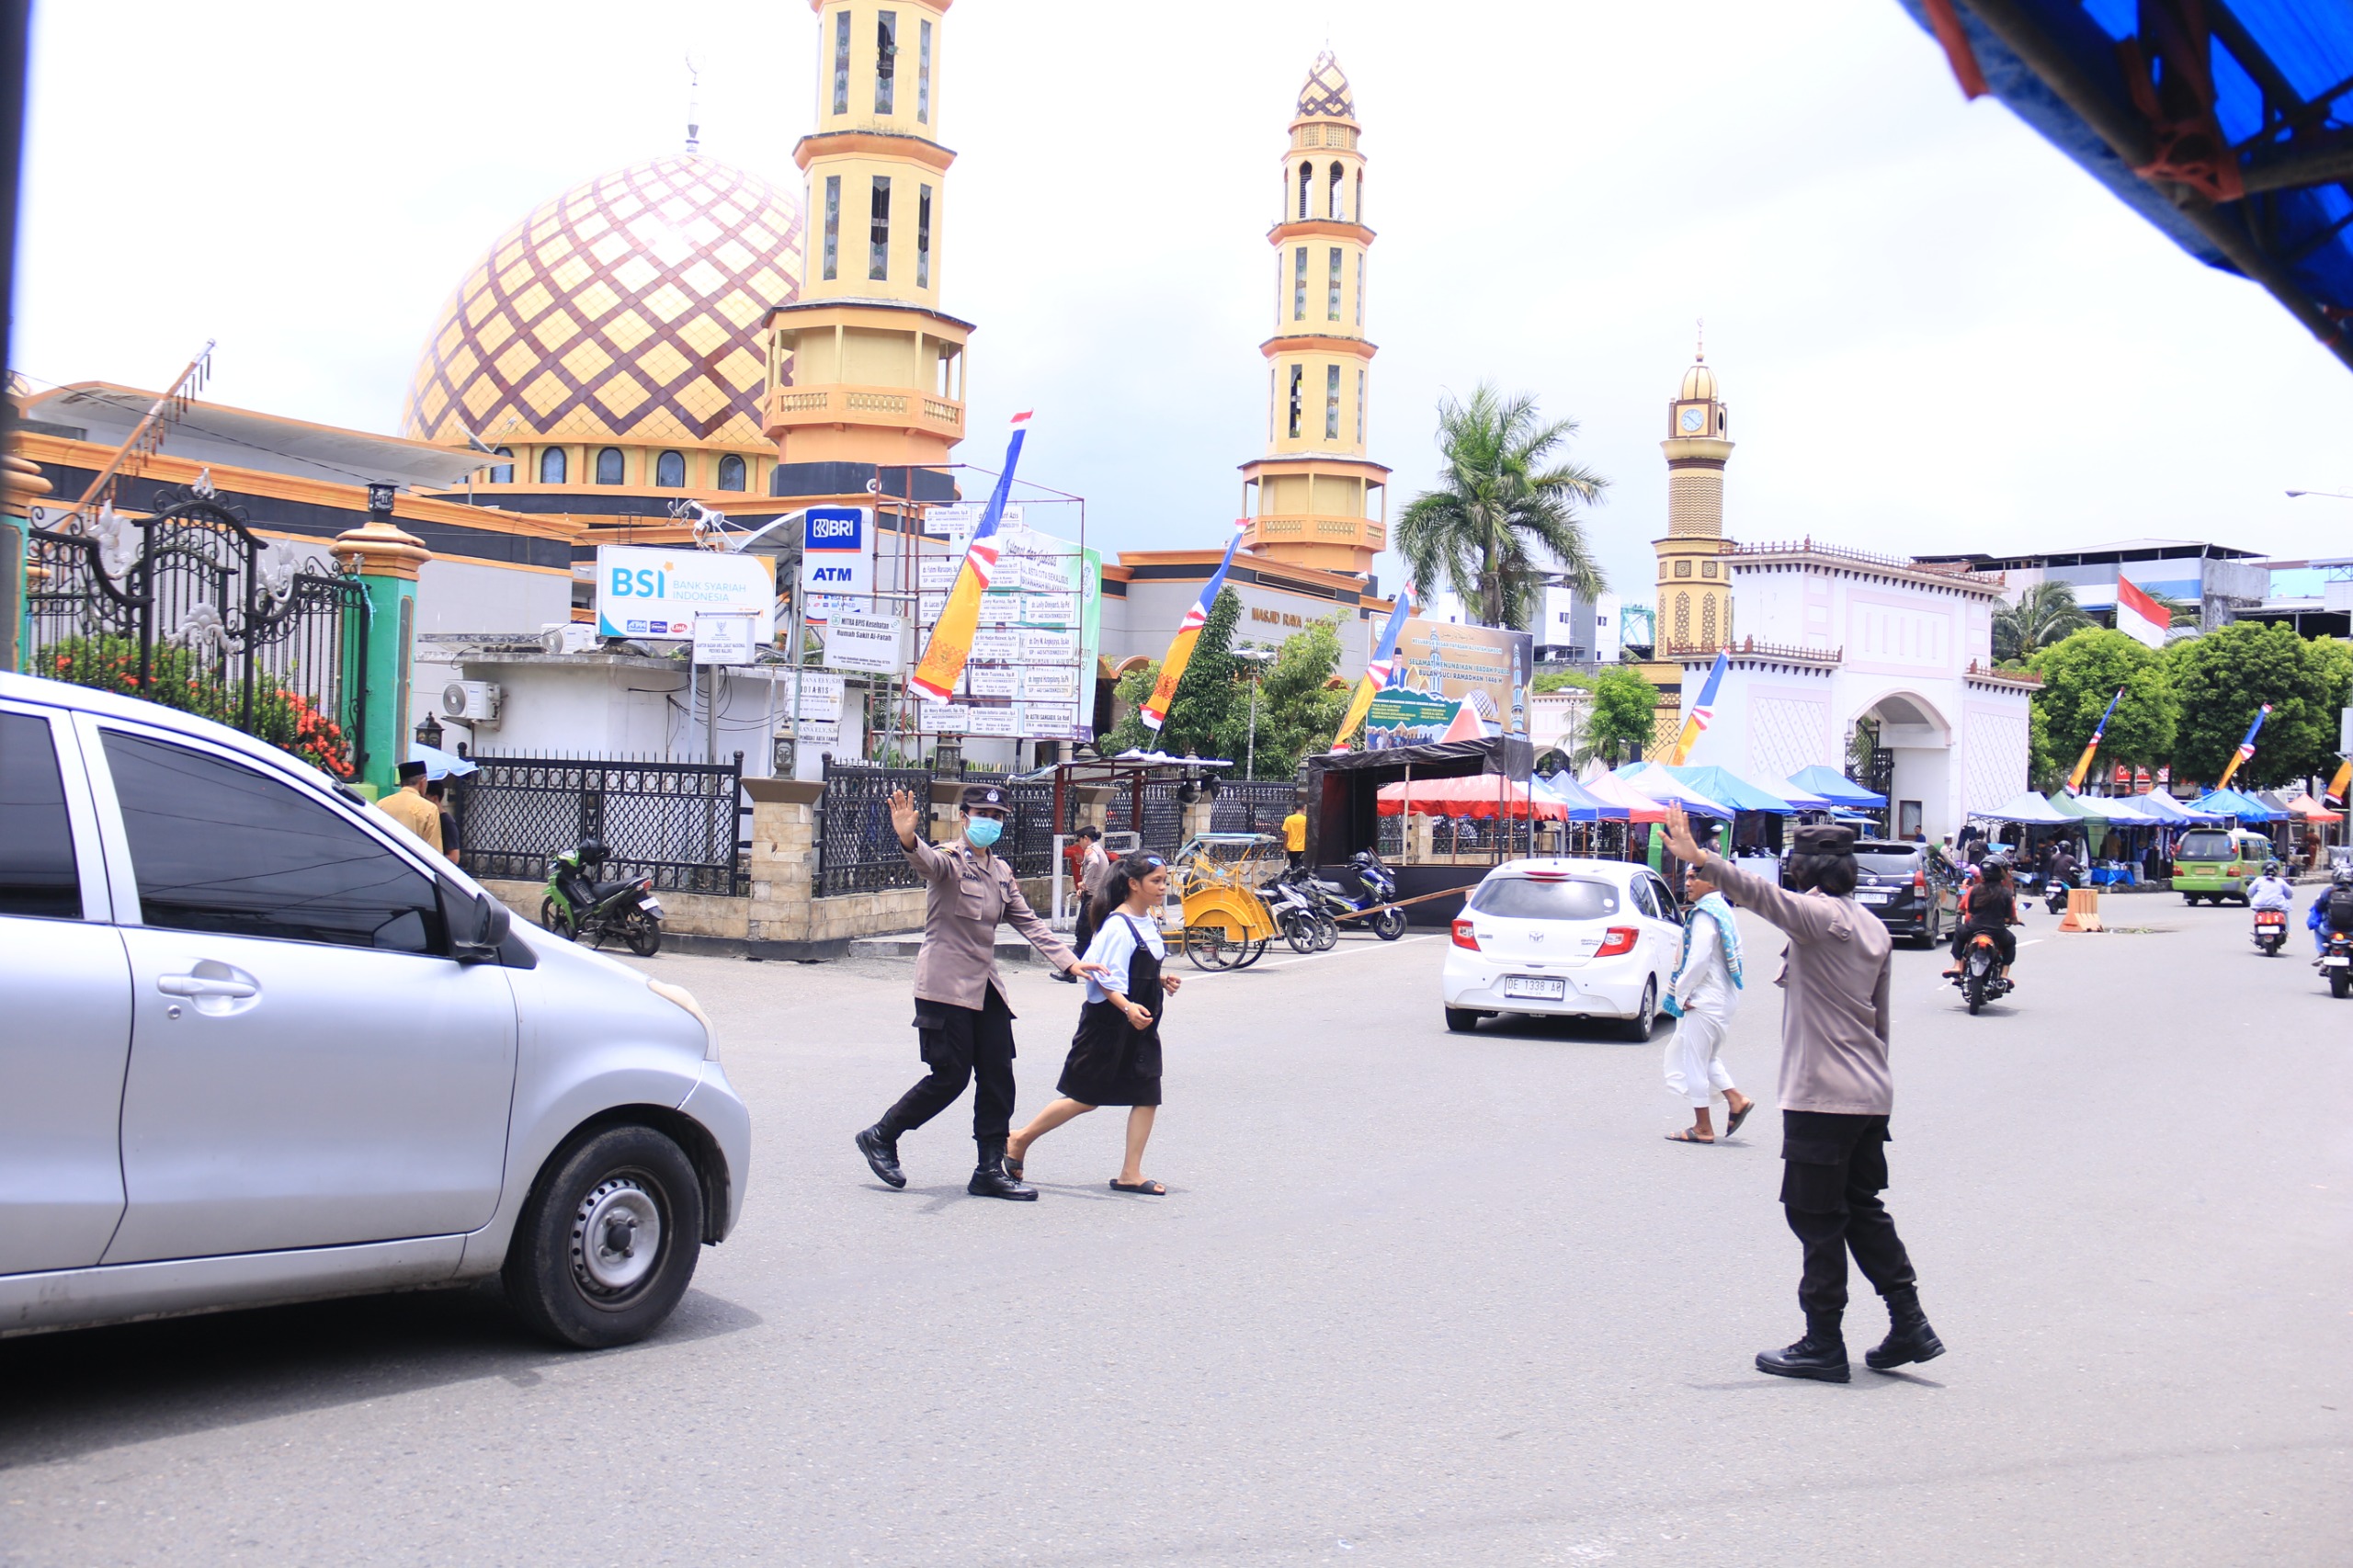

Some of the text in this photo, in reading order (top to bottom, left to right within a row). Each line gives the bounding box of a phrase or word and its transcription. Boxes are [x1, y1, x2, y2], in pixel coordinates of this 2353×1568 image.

[830, 520, 854, 537] BRI
[812, 567, 852, 581] ATM
[612, 567, 665, 598] BSI
[673, 580, 746, 593] BANK SYARIAH
[673, 591, 730, 602] INDONESIA
[841, 618, 855, 626] MITRA
[866, 619, 890, 630] Kesehatan
[1251, 608, 1279, 624] MASJID
[1282, 613, 1302, 629] RAYA
[836, 630, 856, 638] Rumah
[856, 631, 870, 639] Sakit
[1409, 658, 1435, 666] SELAMAT
[1436, 661, 1472, 671] MENUNAIKAN
[1453, 673, 1483, 681] RAMADHAN
[1507, 978, 1518, 990] DE
[1525, 980, 1545, 991] 1338
